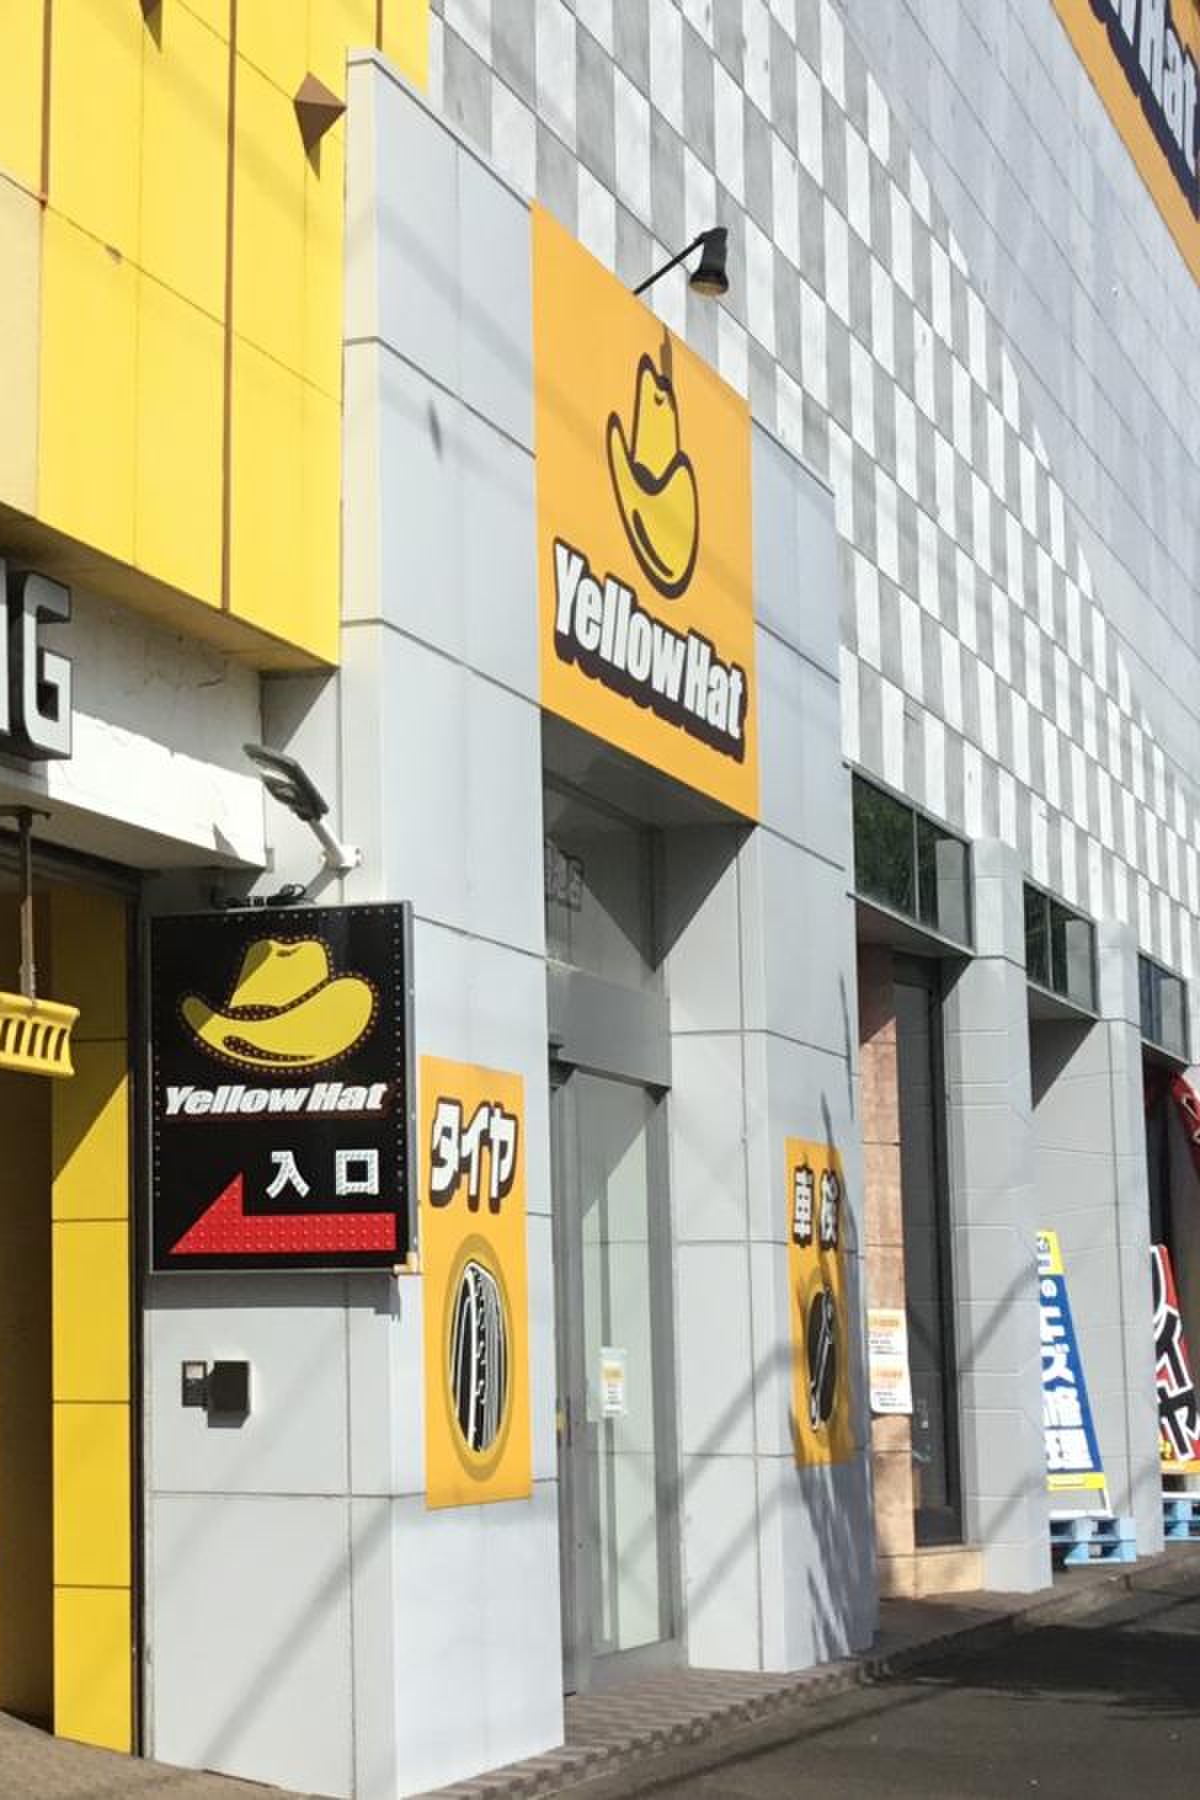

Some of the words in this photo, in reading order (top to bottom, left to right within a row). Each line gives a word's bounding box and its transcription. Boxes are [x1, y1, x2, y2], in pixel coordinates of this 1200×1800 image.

[265, 1149, 379, 1198] 入口
[430, 1099, 517, 1212] タイヤ
